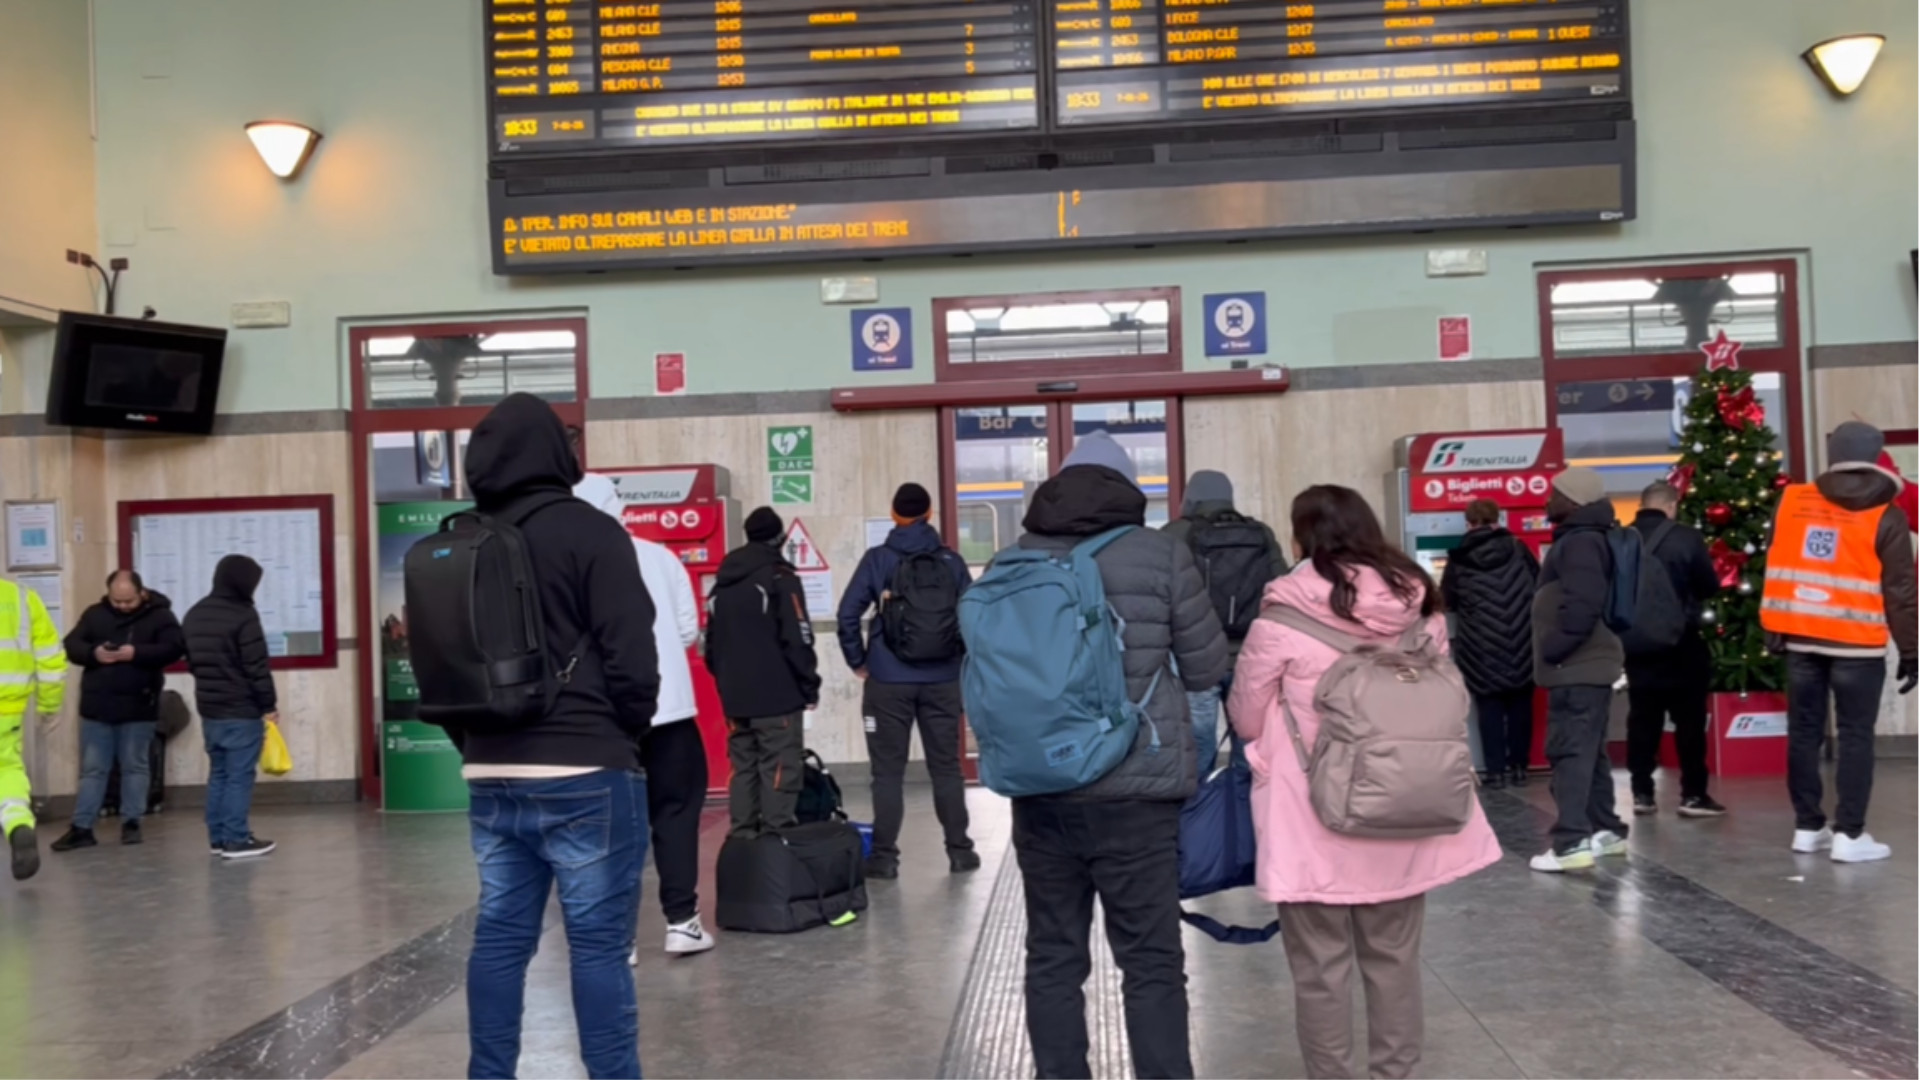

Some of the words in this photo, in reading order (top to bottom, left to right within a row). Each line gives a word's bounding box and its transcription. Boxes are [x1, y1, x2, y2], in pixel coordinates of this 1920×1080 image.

[600, 7, 636, 18] MILANO
[1167, 12, 1199, 24] LECCE
[601, 24, 637, 37] MILANO
[1168, 30, 1213, 43] BOLOGNA
[602, 43, 640, 55] ANCONA
[603, 60, 647, 73] PESCARA
[966, 42, 974, 55] 3
[1168, 50, 1205, 62] MILANO
[603, 79, 639, 92] MILANO
[559, 215, 589, 230] INFO
[591, 213, 614, 228] SUI
[616, 212, 662, 227] CANALI
[664, 209, 695, 225] WEB
[695, 208, 706, 224] E
[710, 208, 725, 223] IN
[504, 238, 518, 254] E'
[520, 237, 572, 253] VIETATO
[573, 233, 665, 250] OLTREPASSARE
[668, 232, 687, 246] LA
[687, 230, 728, 246] LINEA
[729, 228, 776, 244] GIALLA
[780, 227, 795, 241] IN
[795, 224, 844, 240] ATTESA
[844, 222, 869, 239] DEI
[873, 221, 908, 237] TRENI
[980, 413, 1015, 430] Bar
[778, 461, 804, 470] DAE
[1460, 456, 1528, 466] TRENITALIA
[1447, 477, 1502, 492] Biglietti
[617, 490, 680, 500] RENITALIA
[399, 514, 442, 524] EMILI
